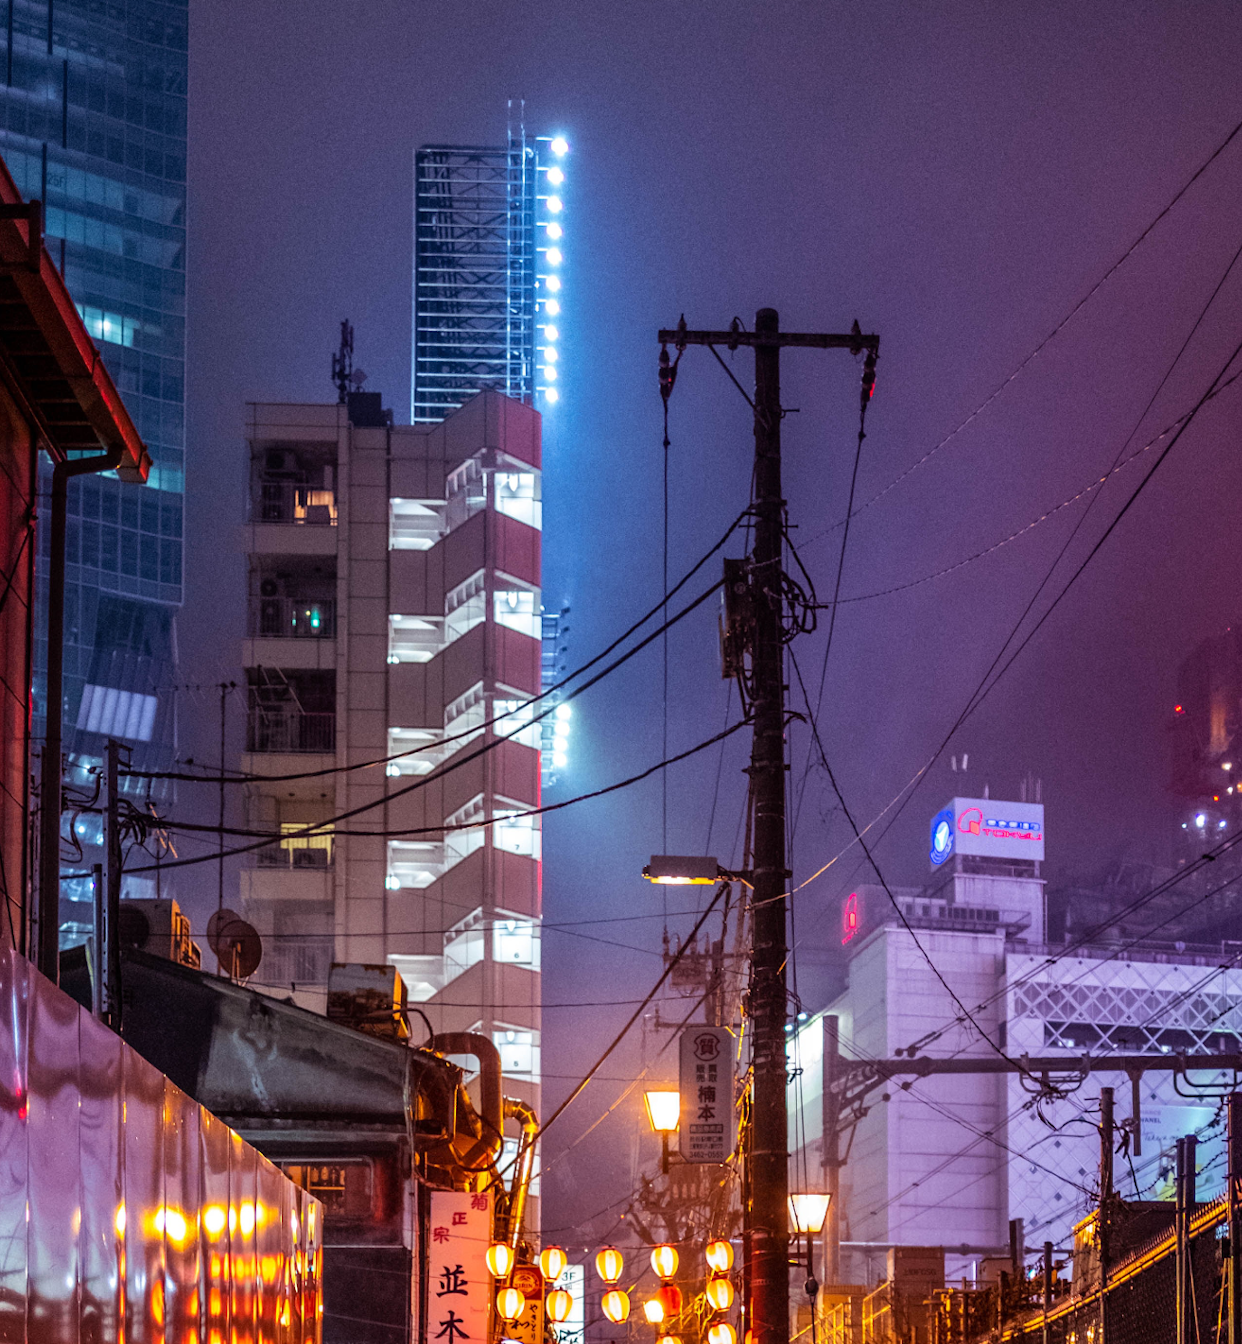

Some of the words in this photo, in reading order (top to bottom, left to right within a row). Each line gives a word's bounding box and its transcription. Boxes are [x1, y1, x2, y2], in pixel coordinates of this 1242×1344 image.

[983, 828, 1042, 841] TOKYU
[700, 1038, 714, 1055] 質
[697, 1086, 716, 1121] 楠本
[433, 1193, 488, 1244] 菊正宗
[562, 1272, 576, 1281] 3F
[529, 1304, 538, 1341] やきとり
